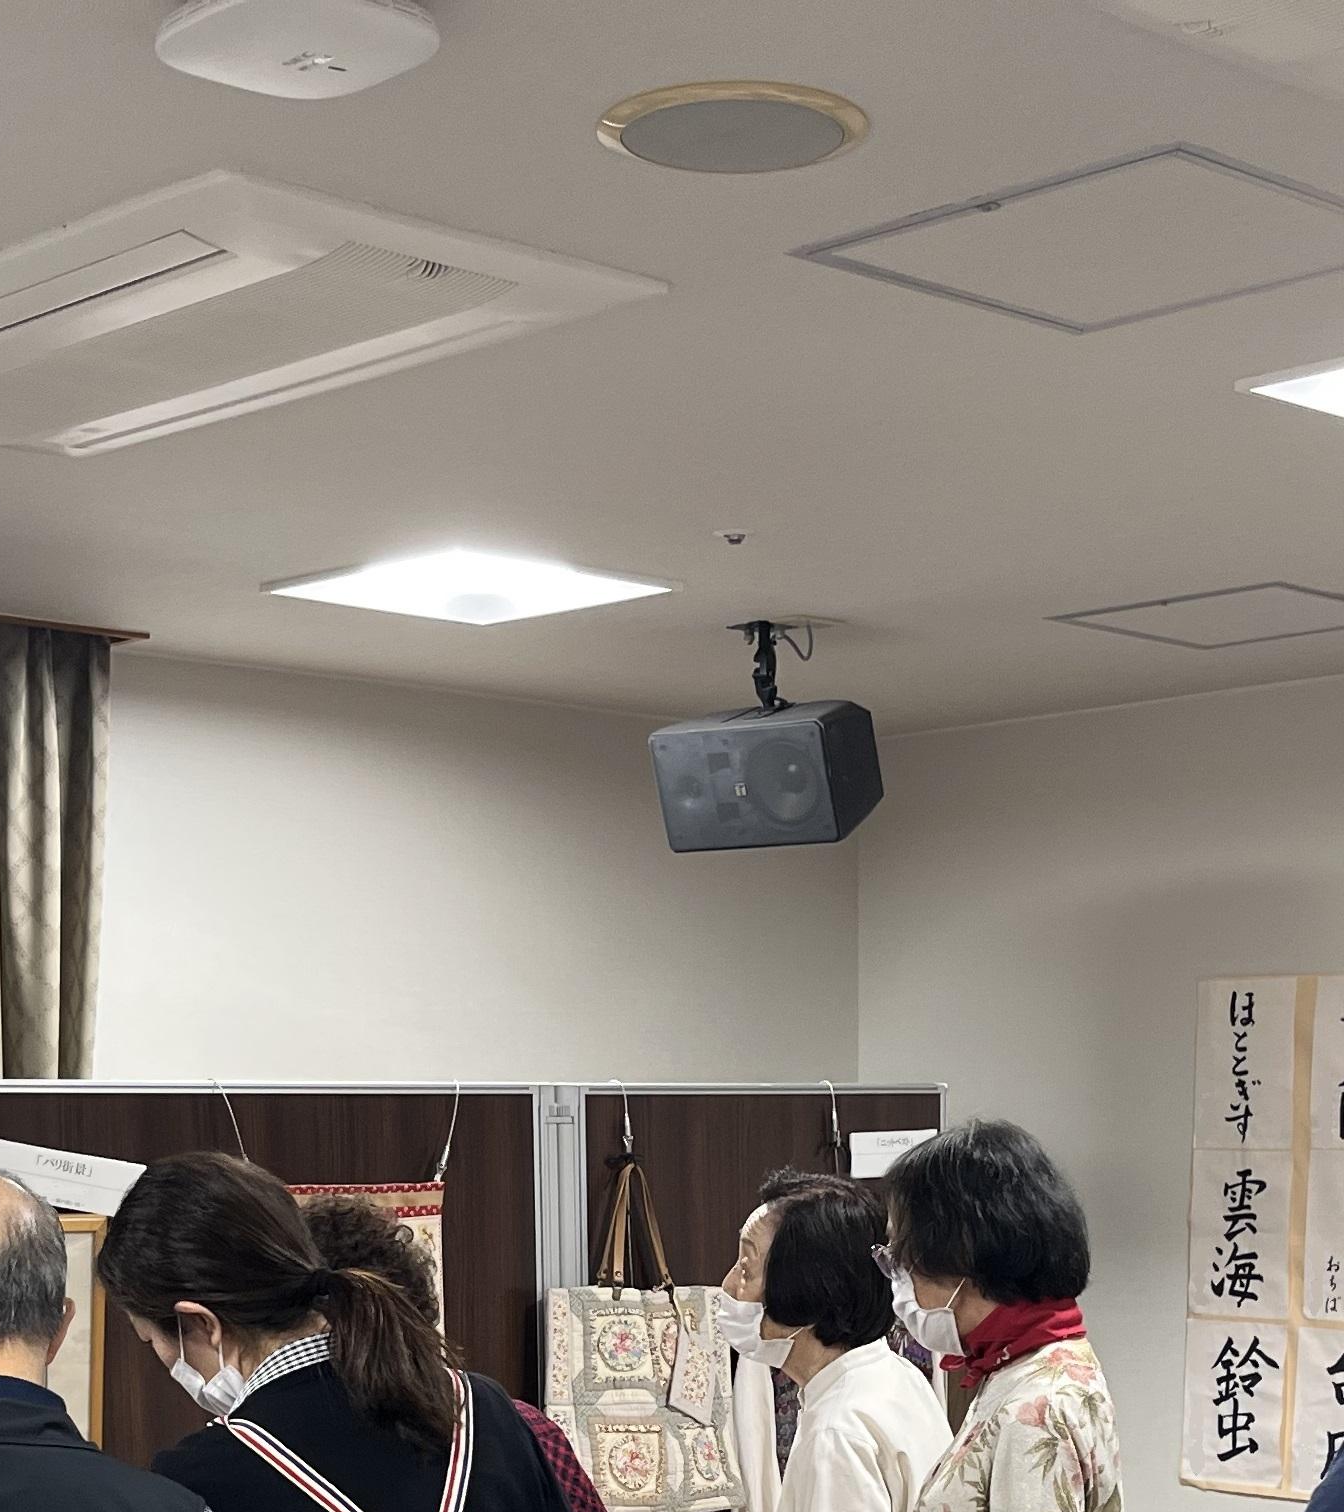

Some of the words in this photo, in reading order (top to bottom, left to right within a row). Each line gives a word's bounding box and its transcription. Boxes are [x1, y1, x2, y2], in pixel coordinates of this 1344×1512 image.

[1224, 990, 1262, 1144] ほととぎす
[1210, 1168, 1267, 1308] 雲海
[1325, 1255, 1342, 1314] おちば
[1211, 1335, 1280, 1462] 鈴虫
